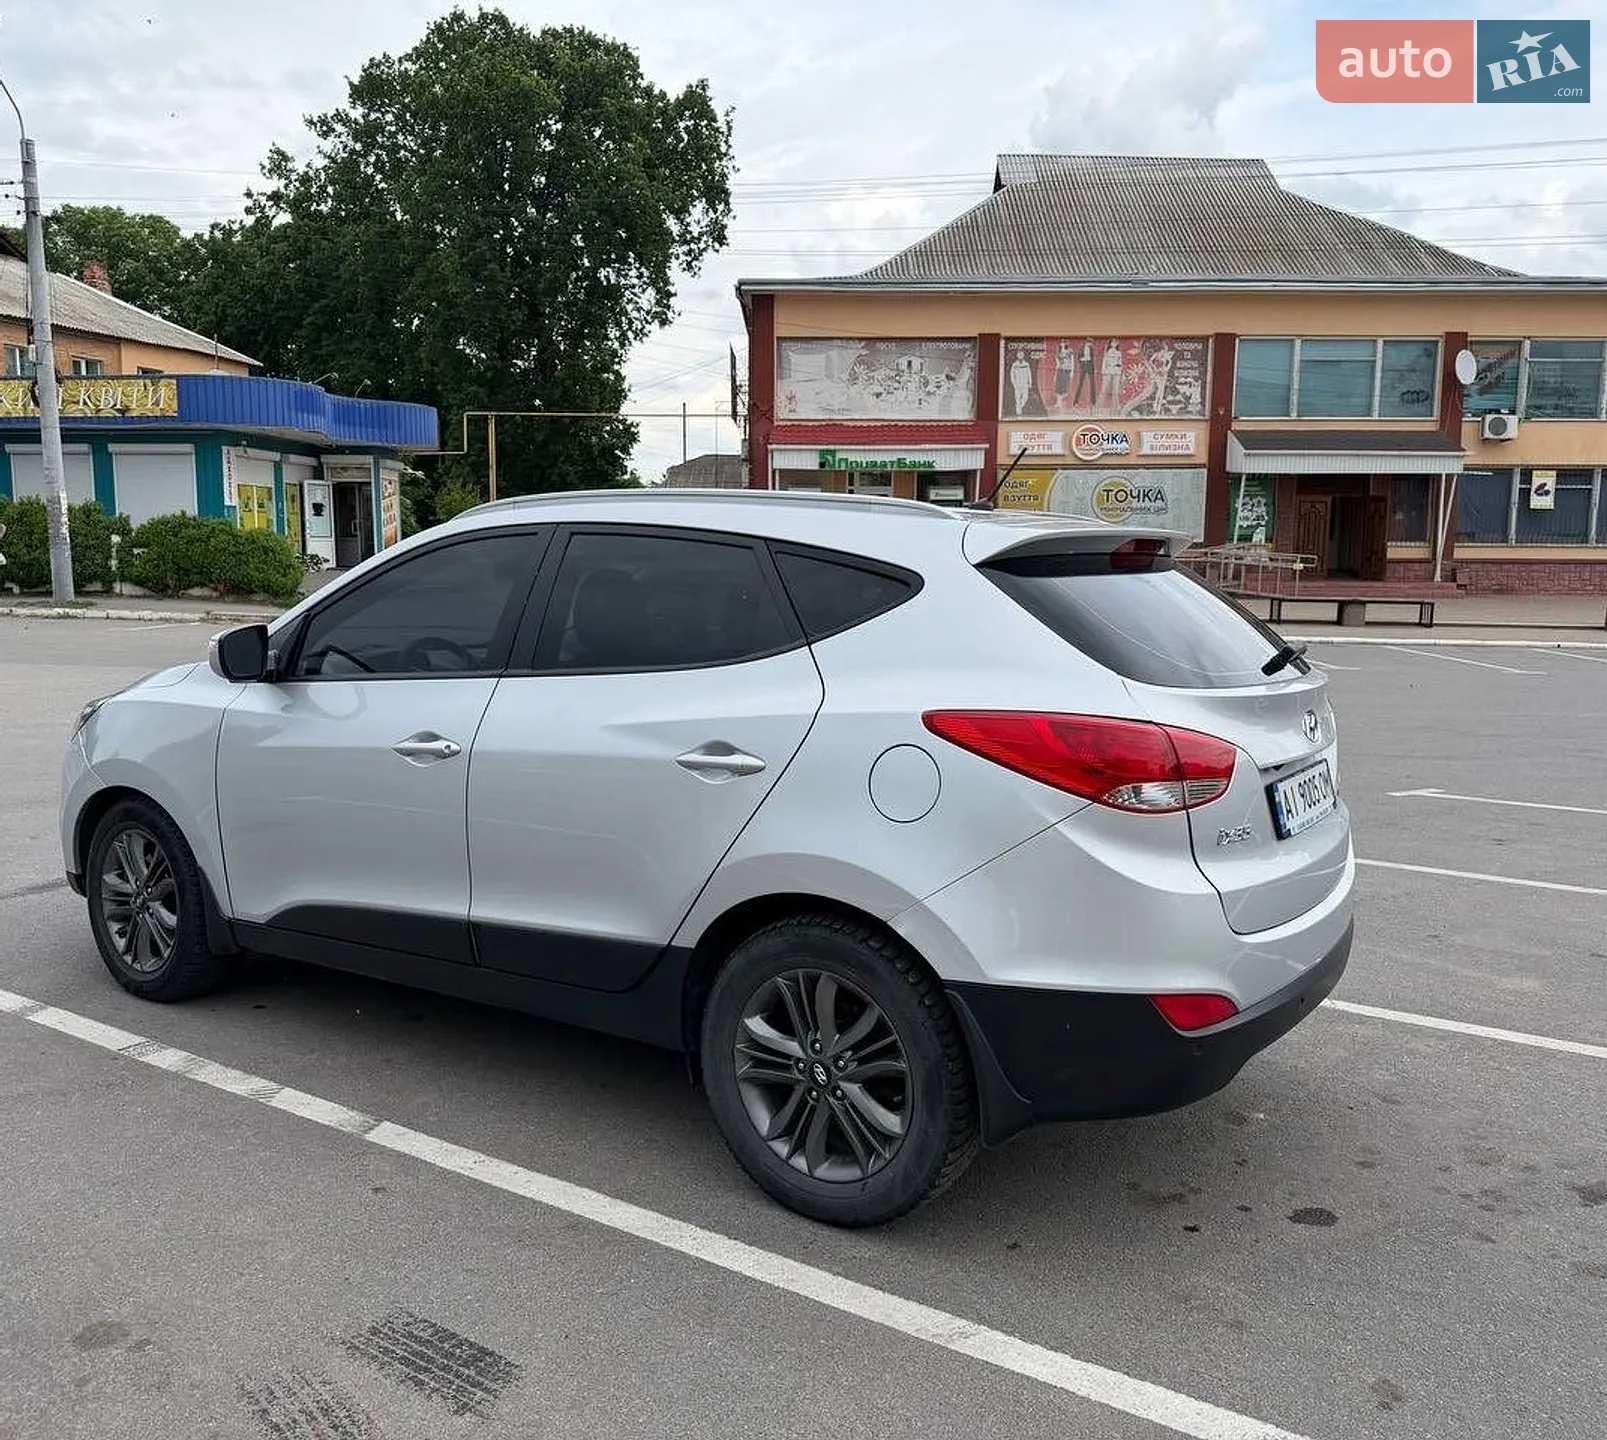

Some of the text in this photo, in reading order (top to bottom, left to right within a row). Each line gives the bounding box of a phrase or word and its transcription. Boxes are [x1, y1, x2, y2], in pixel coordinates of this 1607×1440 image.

[78, 386, 167, 410] КВІТИ
[1079, 433, 1130, 446] ТОЧКА
[1152, 433, 1188, 441] СУМКИ
[837, 457, 938, 470] ПриватБанк
[1003, 480, 1028, 489] ОДЯГ
[1003, 494, 1039, 503] ВЗУТТЯ
[1102, 488, 1165, 504] ТОЧКА
